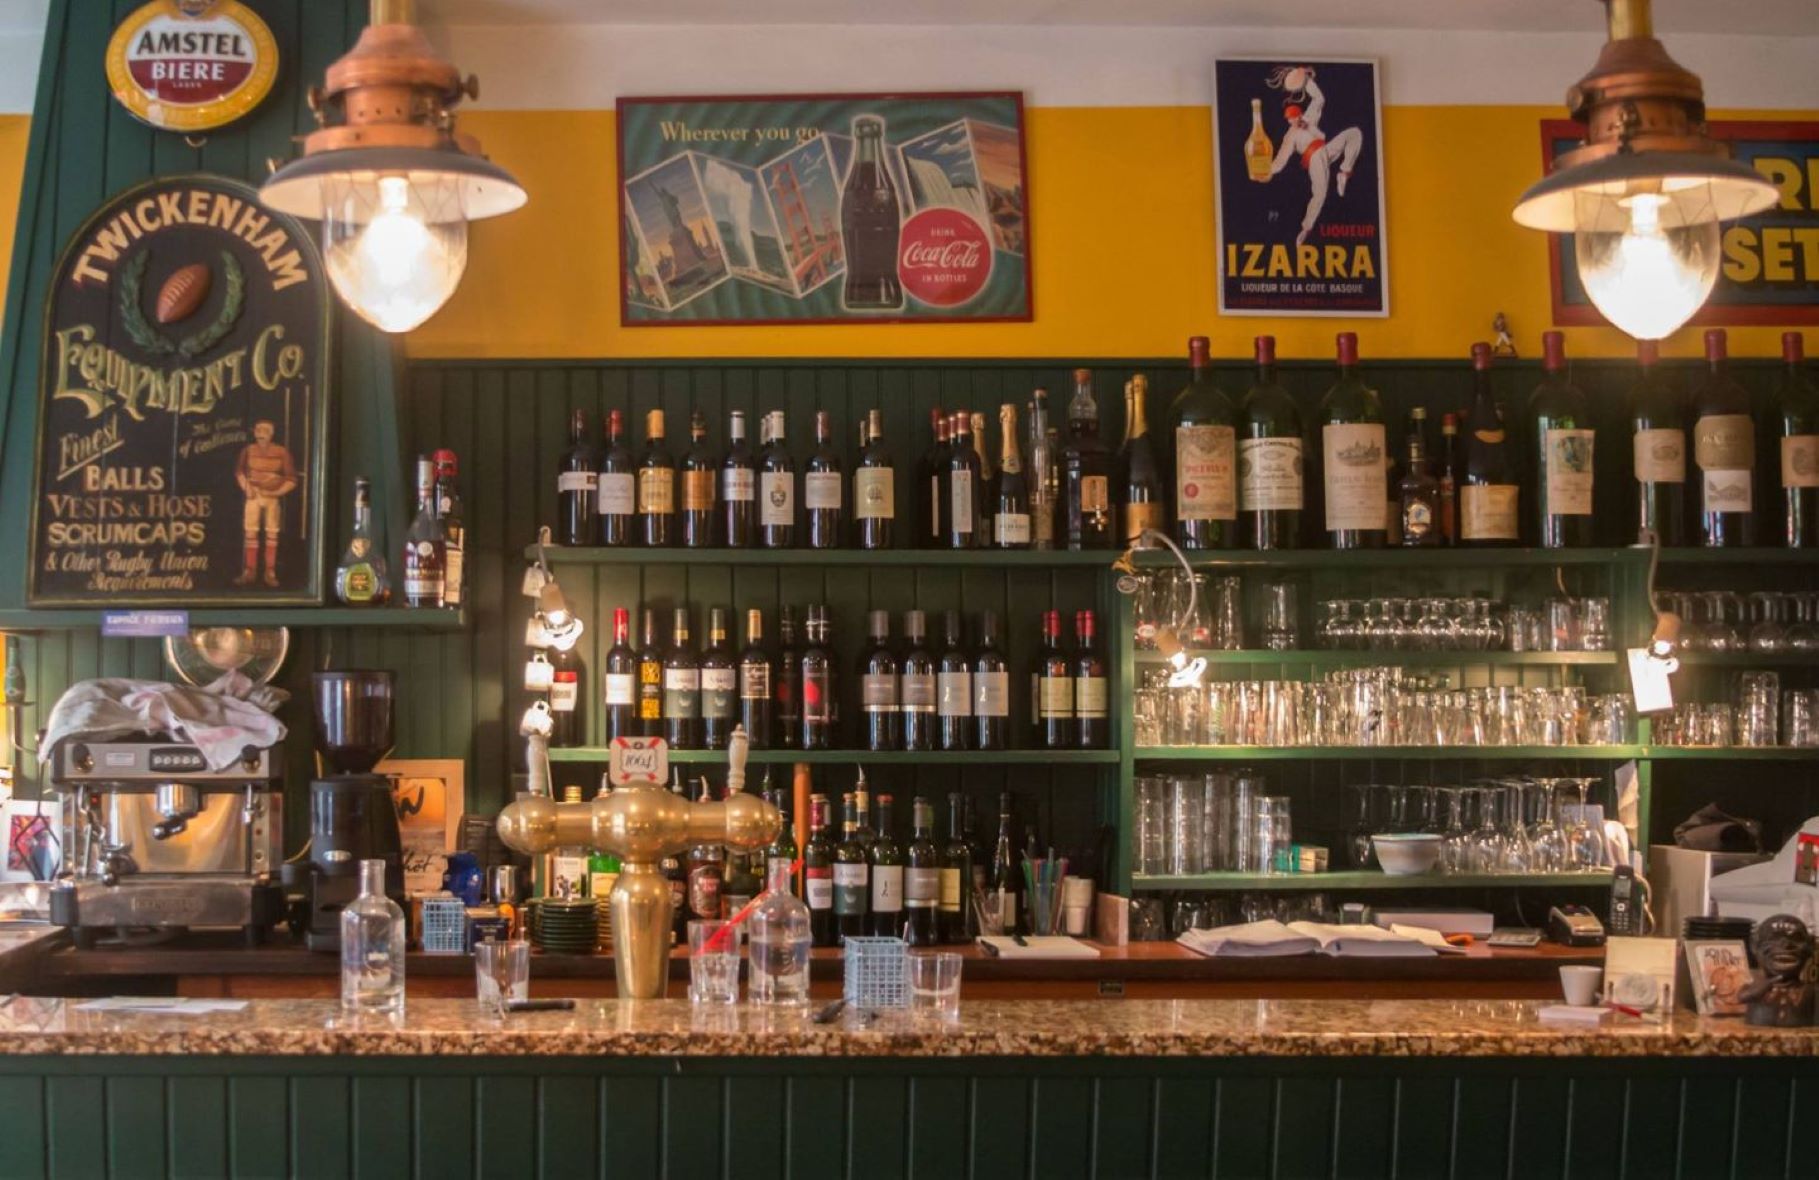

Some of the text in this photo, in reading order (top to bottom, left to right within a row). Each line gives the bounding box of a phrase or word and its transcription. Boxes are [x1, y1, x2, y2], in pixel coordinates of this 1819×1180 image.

[136, 30, 246, 57] AMSTEL
[152, 61, 226, 81] BIERE
[660, 120, 819, 147] Wherever you go
[72, 190, 308, 292] TWICKENHAM
[1319, 224, 1375, 238] LIQUEUR
[902, 240, 982, 270] Coca-Cola
[1227, 243, 1376, 279] IZARRA
[1241, 283, 1278, 294] LIQUEUR
[1280, 283, 1290, 293] DE
[1292, 283, 1302, 293] LA
[1329, 283, 1363, 294] BASQUE
[85, 465, 165, 491] BALLS
[47, 494, 212, 518] VESTS & HOSE
[48, 521, 206, 545] SCRUMCAPS
[106, 550, 154, 578] Rugby
